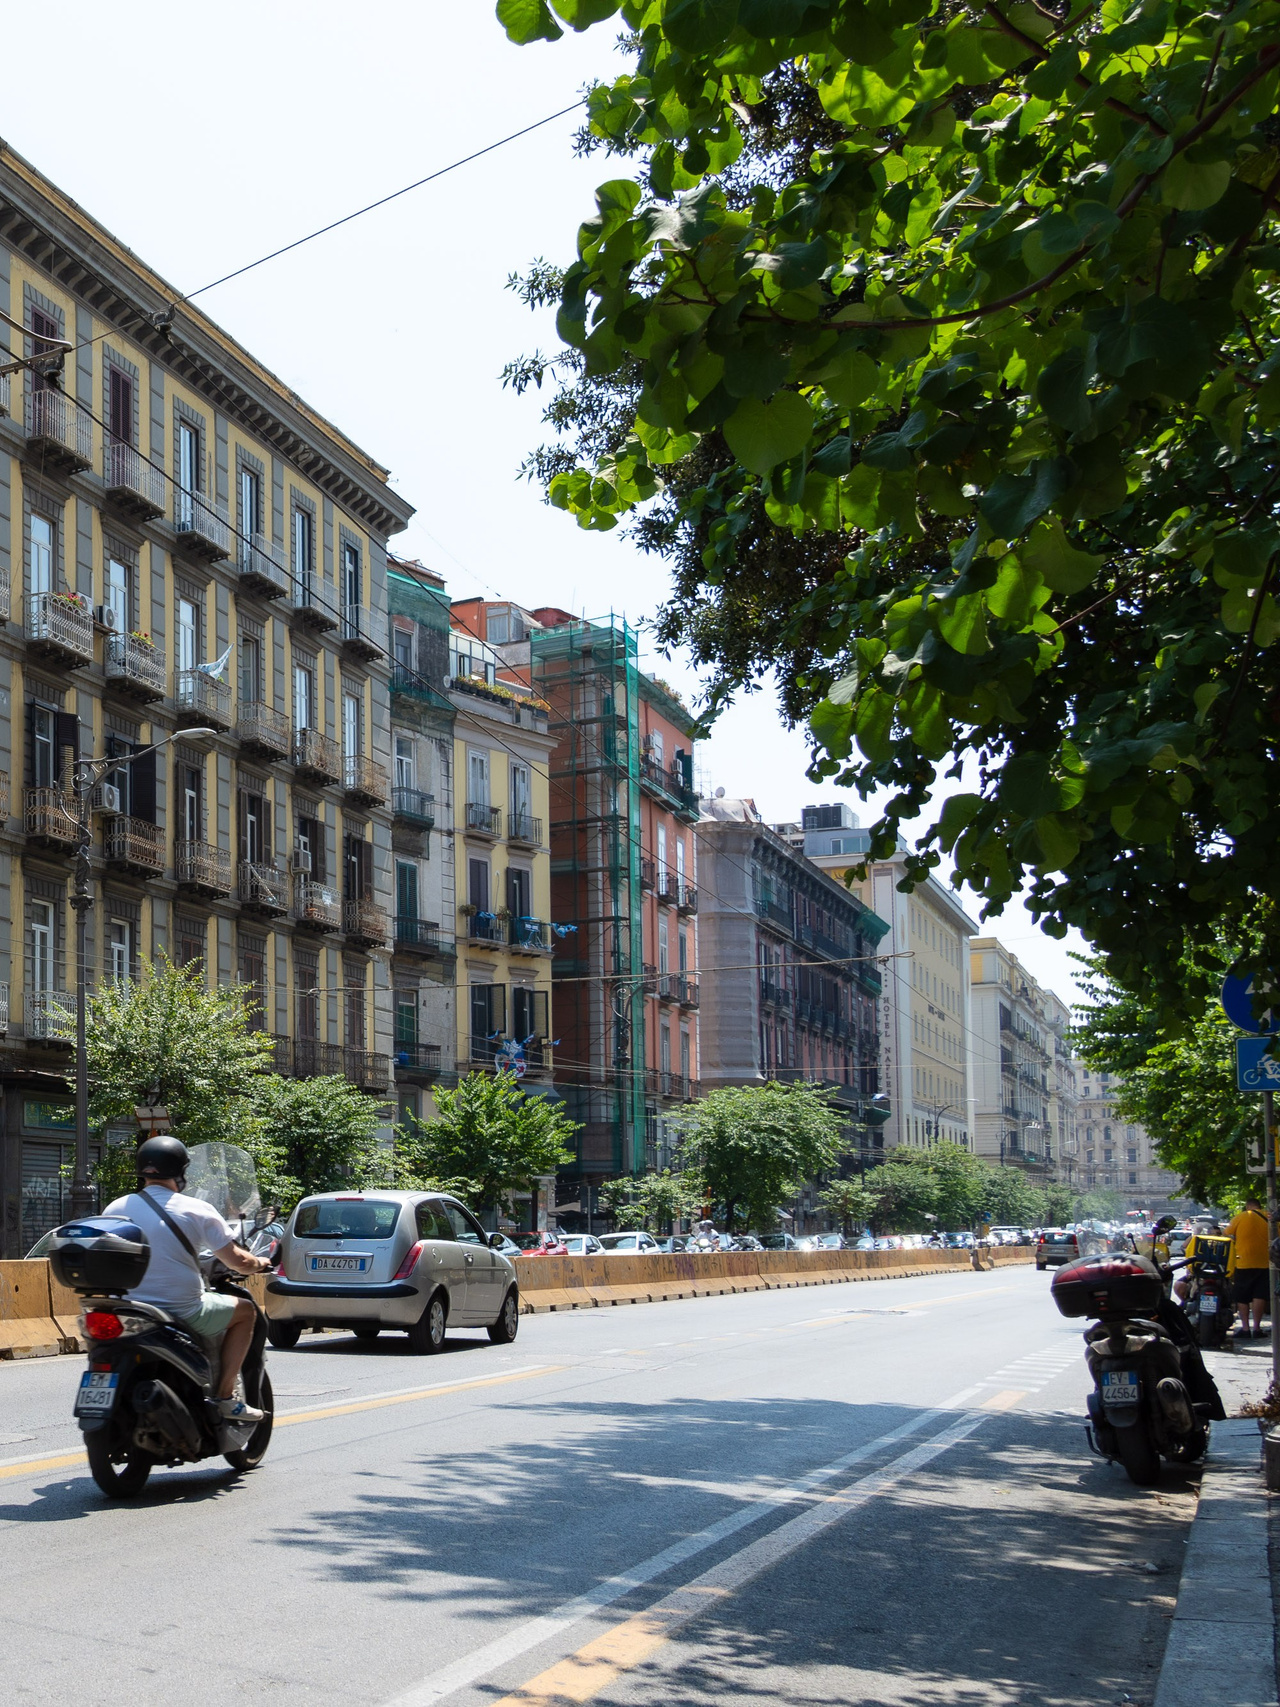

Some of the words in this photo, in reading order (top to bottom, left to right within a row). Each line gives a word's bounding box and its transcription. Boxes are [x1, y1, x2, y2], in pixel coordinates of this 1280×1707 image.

[330, 1259, 360, 1269] 447GT
[79, 1390, 112, 1406] 16481
[1104, 1387, 1137, 1399] 44564
